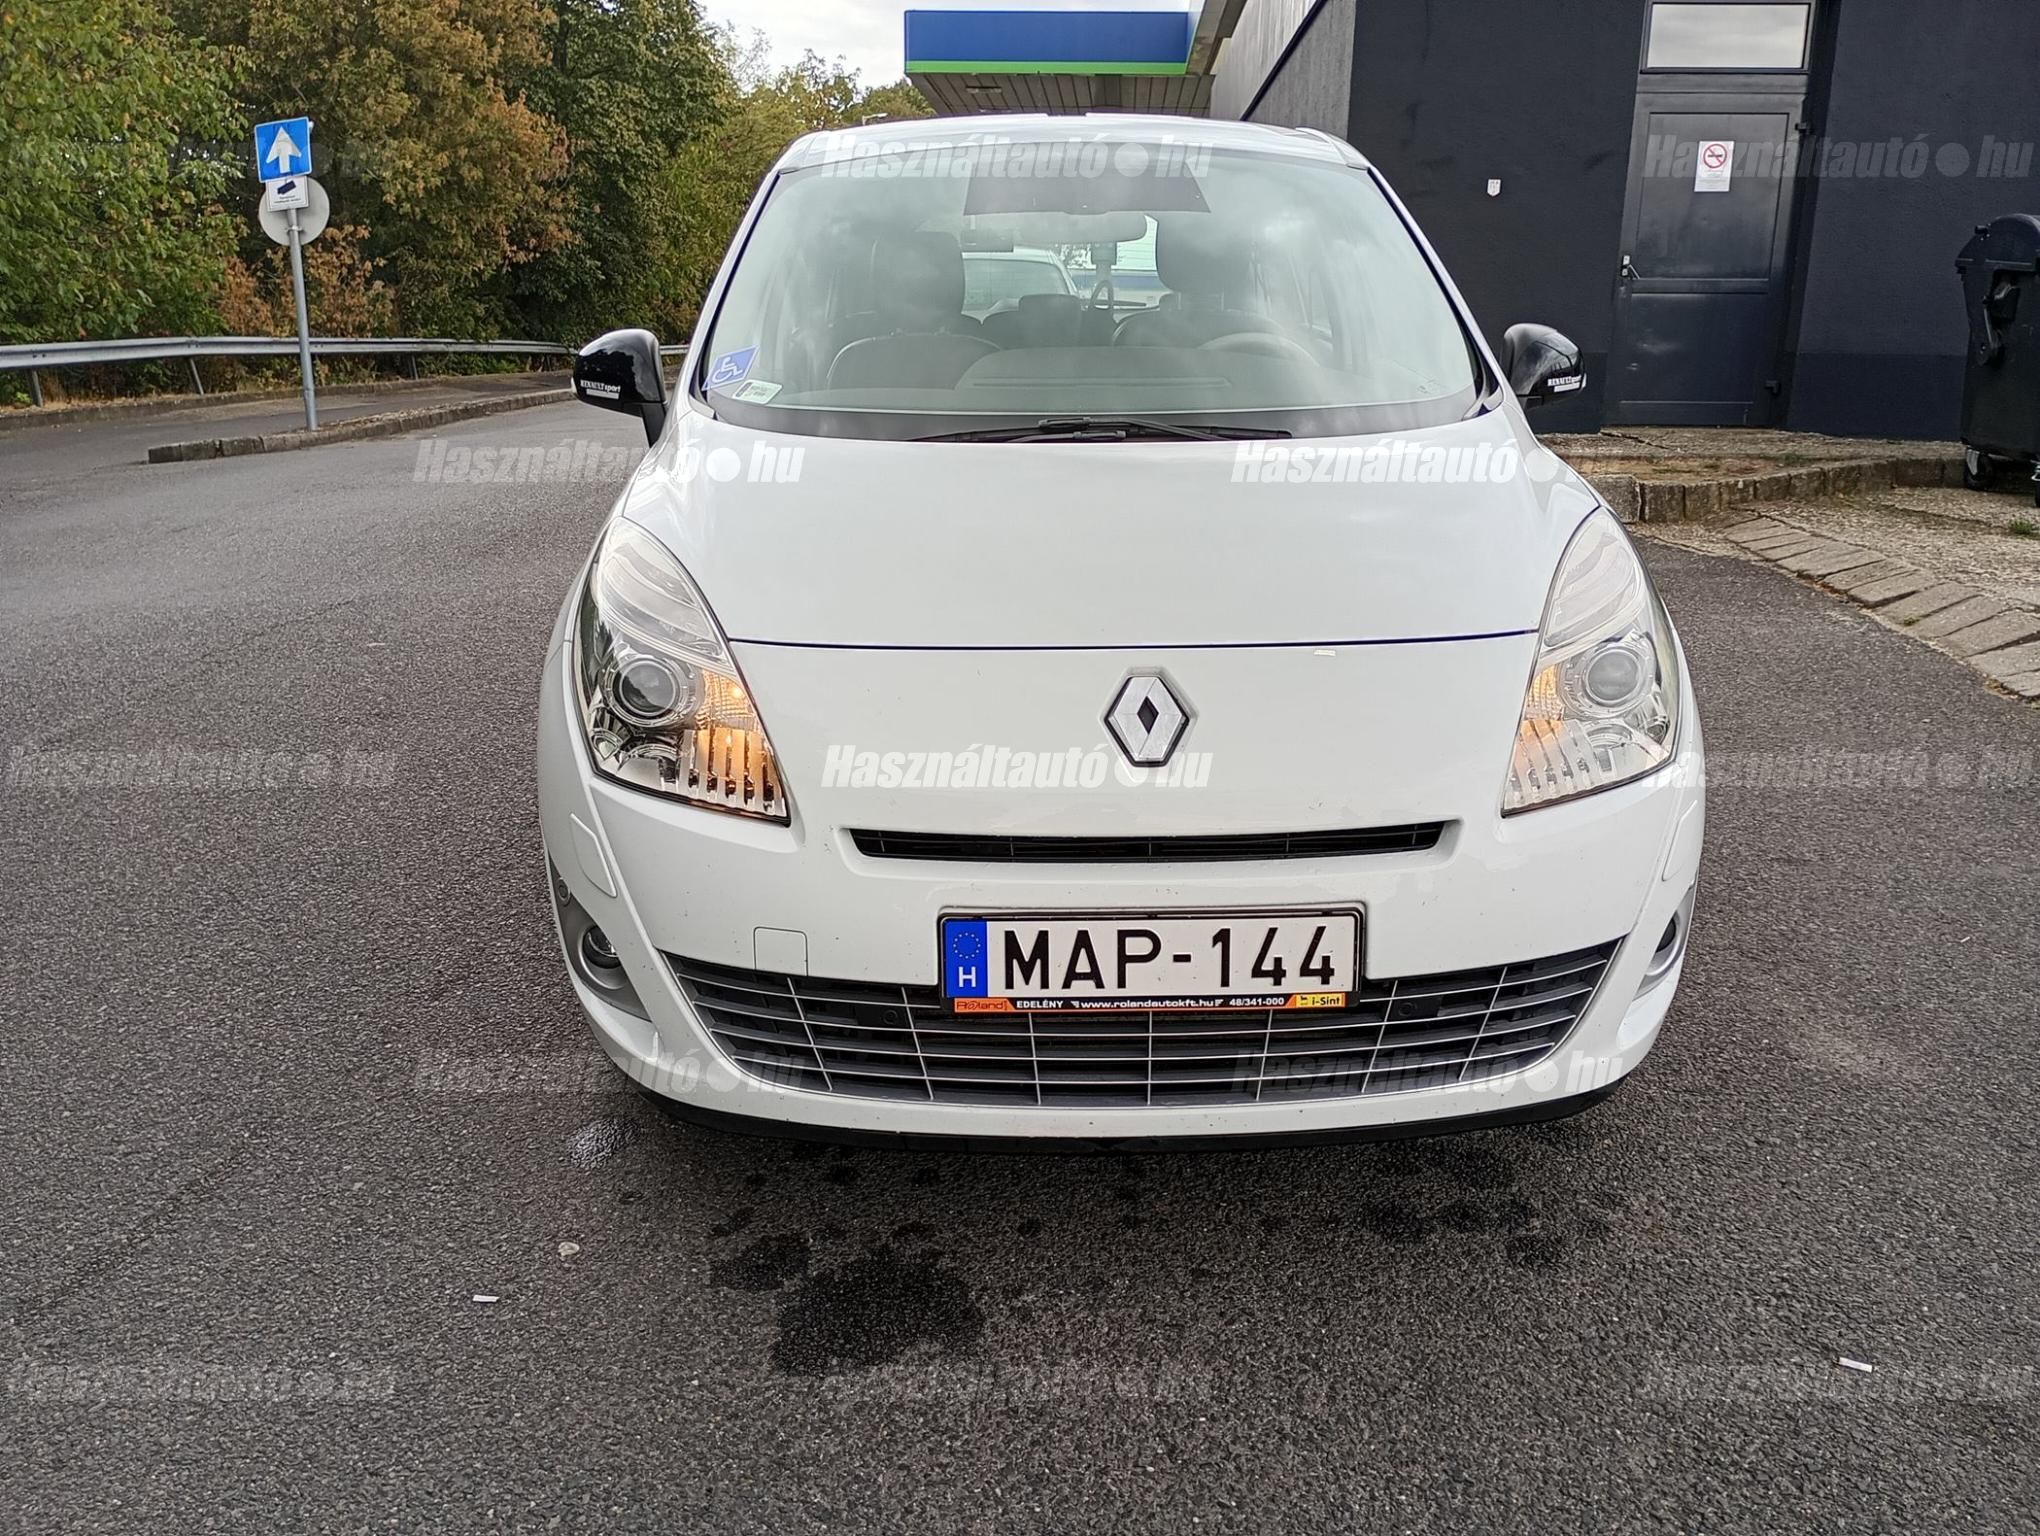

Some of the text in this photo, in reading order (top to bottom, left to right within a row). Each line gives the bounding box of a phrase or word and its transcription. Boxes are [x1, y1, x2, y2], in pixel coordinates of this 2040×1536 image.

[1003, 926, 1335, 990] MAP-144
[958, 966, 977, 988] H
[1016, 999, 1063, 1009] EDELÉNY
[1081, 999, 1214, 1009] www.rolandautokft.hu
[1229, 997, 1285, 1007] 48/341-000
